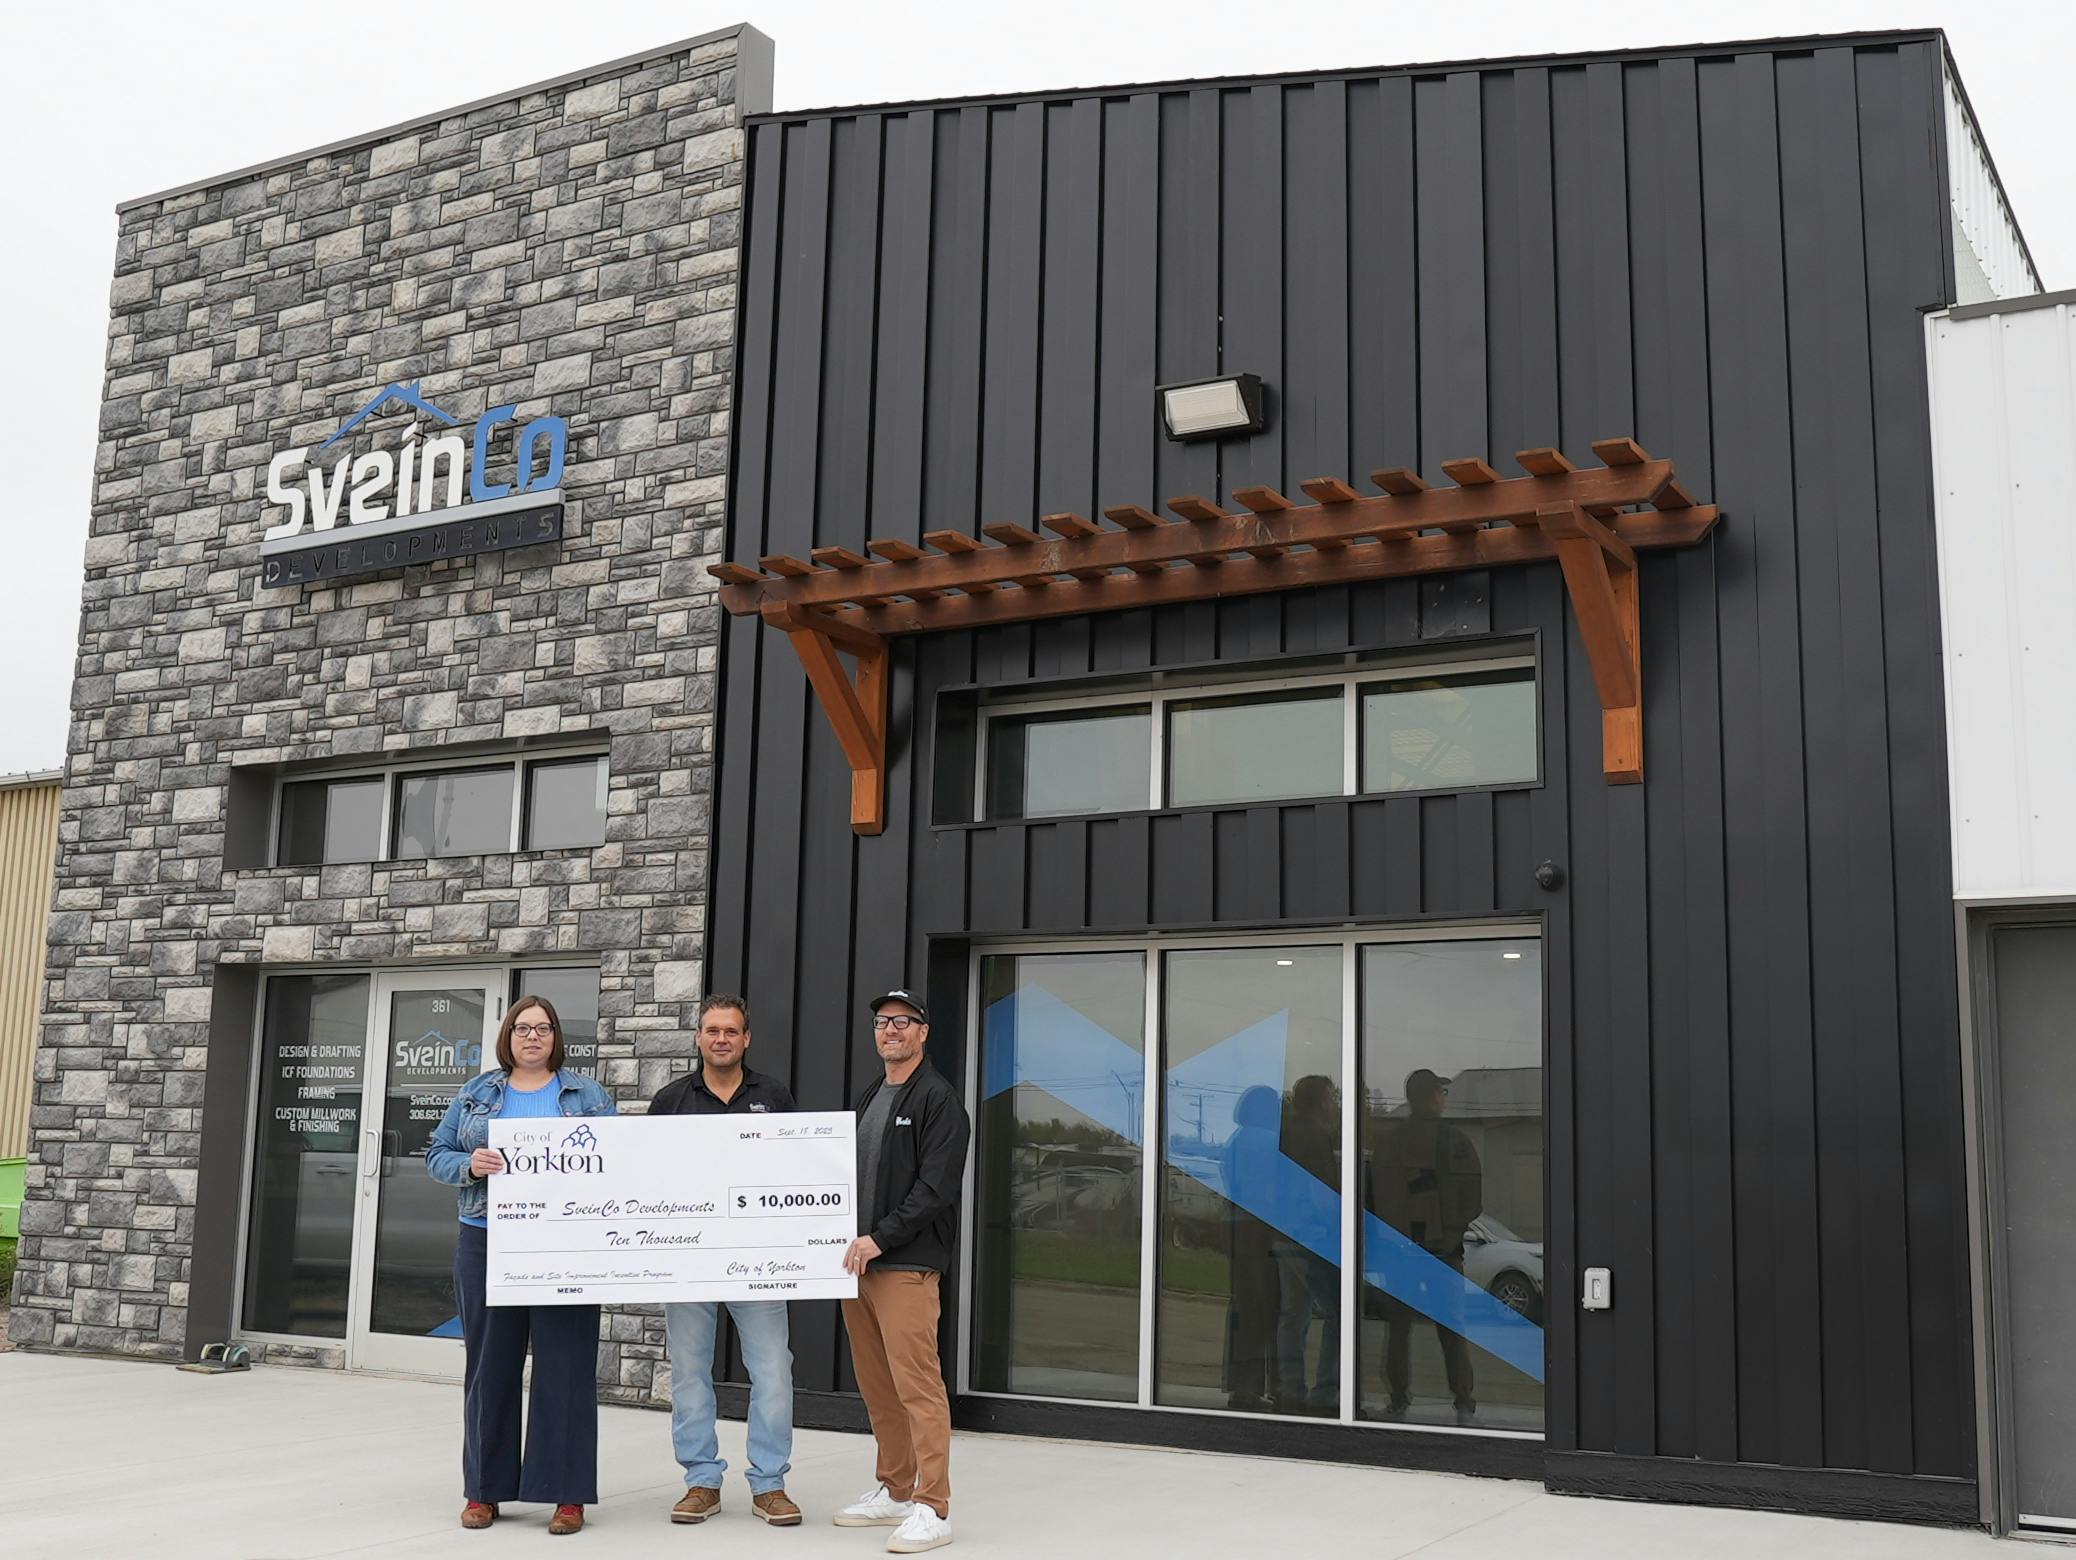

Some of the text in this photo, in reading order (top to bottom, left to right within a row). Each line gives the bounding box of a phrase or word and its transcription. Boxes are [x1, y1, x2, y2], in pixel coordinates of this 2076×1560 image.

[264, 404, 568, 541] SveinCo
[266, 512, 555, 583] DEVELOPMENTS
[432, 1000, 450, 1013] 361
[279, 1045, 361, 1058] DESIGN & DRAFTING
[395, 1039, 482, 1067] SveinCo
[569, 1044, 597, 1057] CONST
[282, 1066, 356, 1079] ICF FOUNDATIONS
[407, 1067, 467, 1075] DEVELOPMENTS
[298, 1087, 335, 1099] FRAMING
[410, 1094, 453, 1106] SveinCo.co
[275, 1107, 357, 1120] CUSTOM MILLWORK
[289, 1120, 340, 1133] & FINISHING
[513, 1131, 552, 1145] City of
[740, 1132, 761, 1140] DATE
[497, 1146, 606, 1176] Yorkton
[737, 1193, 841, 1210] $ 10,000.00
[562, 1199, 716, 1218] SveinCo Developments
[606, 1230, 702, 1247] Ten Thousand
[807, 1238, 848, 1246] DOLLARS
[726, 1260, 806, 1276] City of Yorkton
[748, 1282, 798, 1290] SIGNATURE
